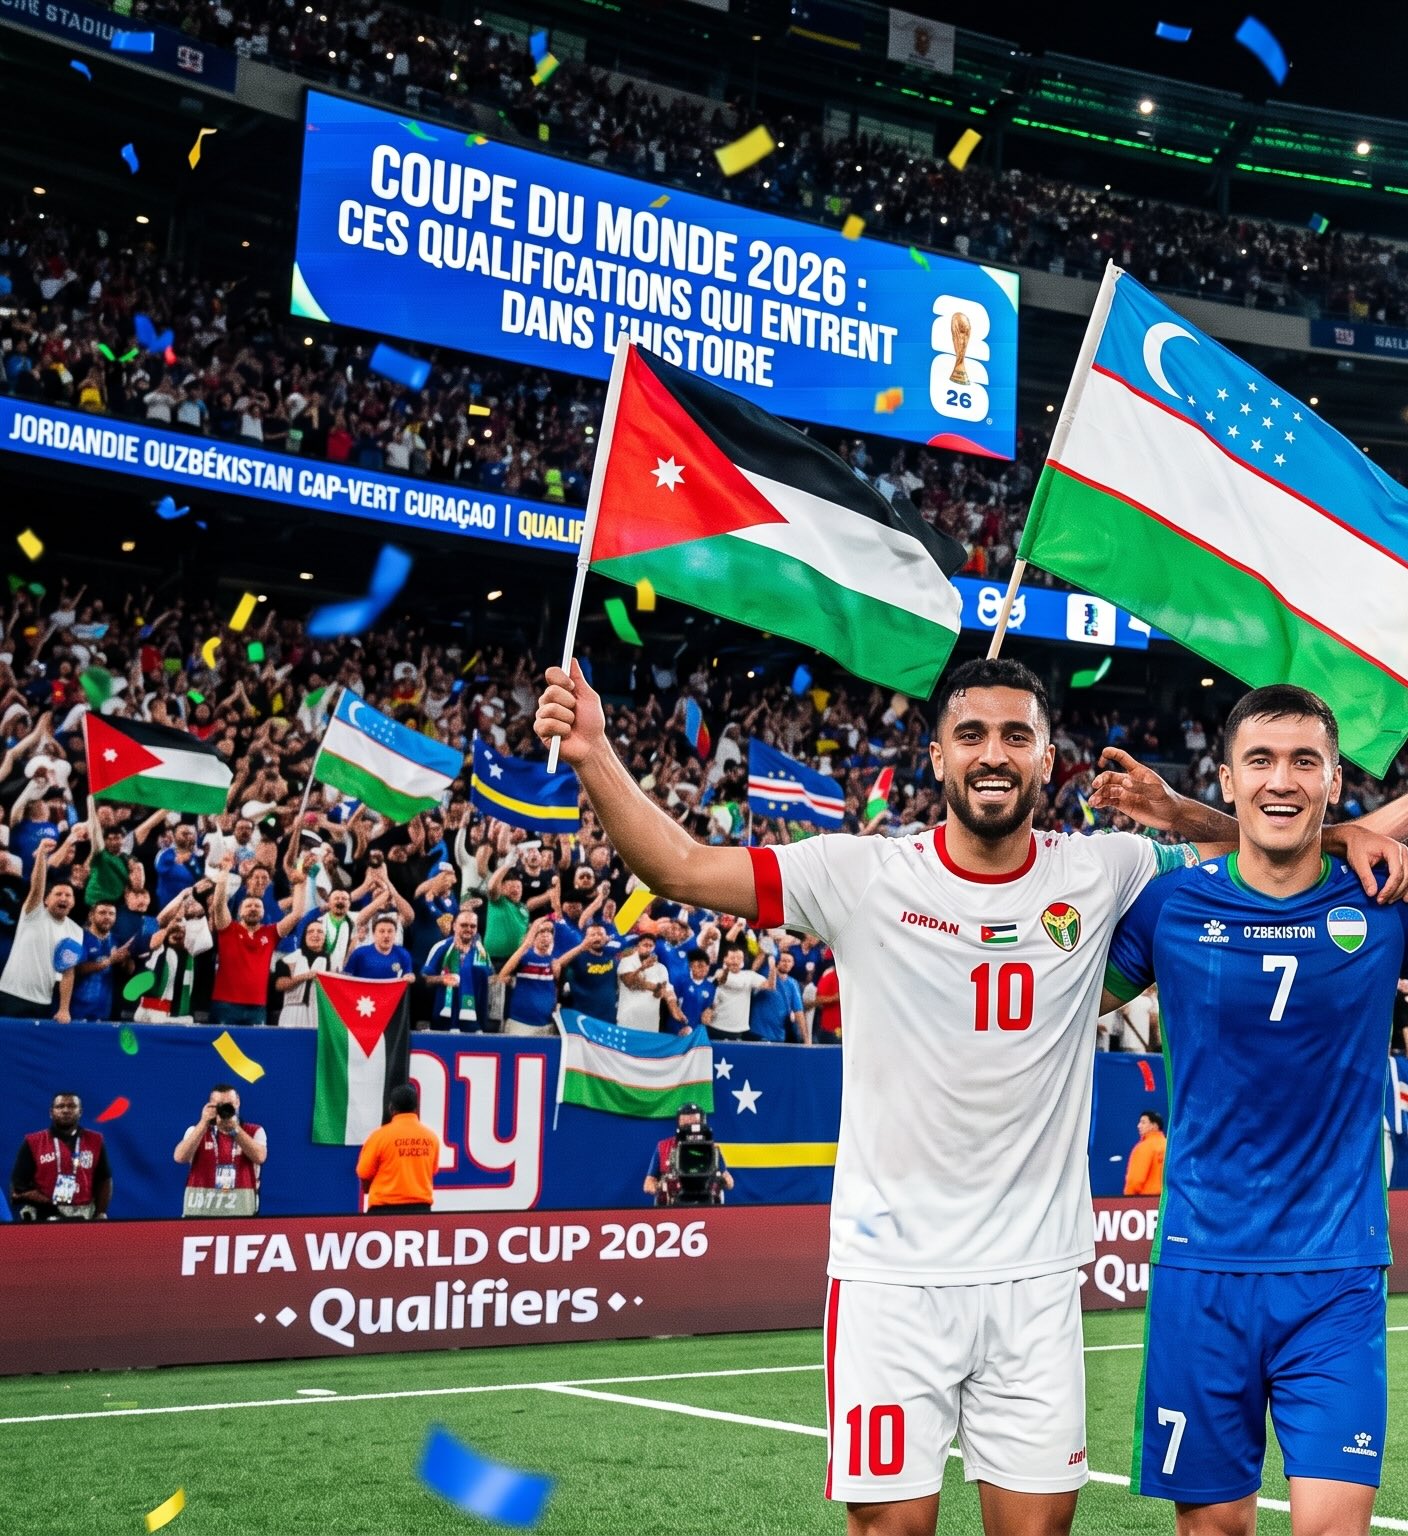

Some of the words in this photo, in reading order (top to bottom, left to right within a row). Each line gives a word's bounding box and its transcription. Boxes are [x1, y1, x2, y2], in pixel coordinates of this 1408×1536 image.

[45, 3, 130, 44] STADIU
[371, 144, 517, 230] COUPE
[527, 184, 585, 245] DU
[596, 201, 738, 283] MONDE
[748, 240, 846, 306] 2026
[338, 199, 410, 256] CES
[418, 219, 692, 320] QUALIFICATIONS
[700, 285, 753, 334] QUI
[761, 298, 898, 364] ENTRENT
[501, 289, 595, 350] DANS
[603, 312, 775, 388] L'HISTOIRE
[946, 389, 972, 408] 26
[9, 413, 140, 464] JORDANDIE
[143, 439, 293, 493] OUZBÉKISTAN
[299, 470, 400, 512] CAP-VERT
[404, 489, 497, 529] CURAÇAO
[518, 510, 586, 545] QUALIF
[901, 911, 960, 936] JORDAN
[970, 962, 1034, 1031] 10
[1262, 954, 1299, 1021] 7
[181, 1234, 298, 1276] FIFA
[305, 1228, 489, 1270] WORLD
[497, 1225, 590, 1264] CUP
[599, 1221, 708, 1260] 2026
[309, 1277, 599, 1348] Qualifiers
[846, 1404, 905, 1476] 10
[1157, 1407, 1187, 1475] 7
